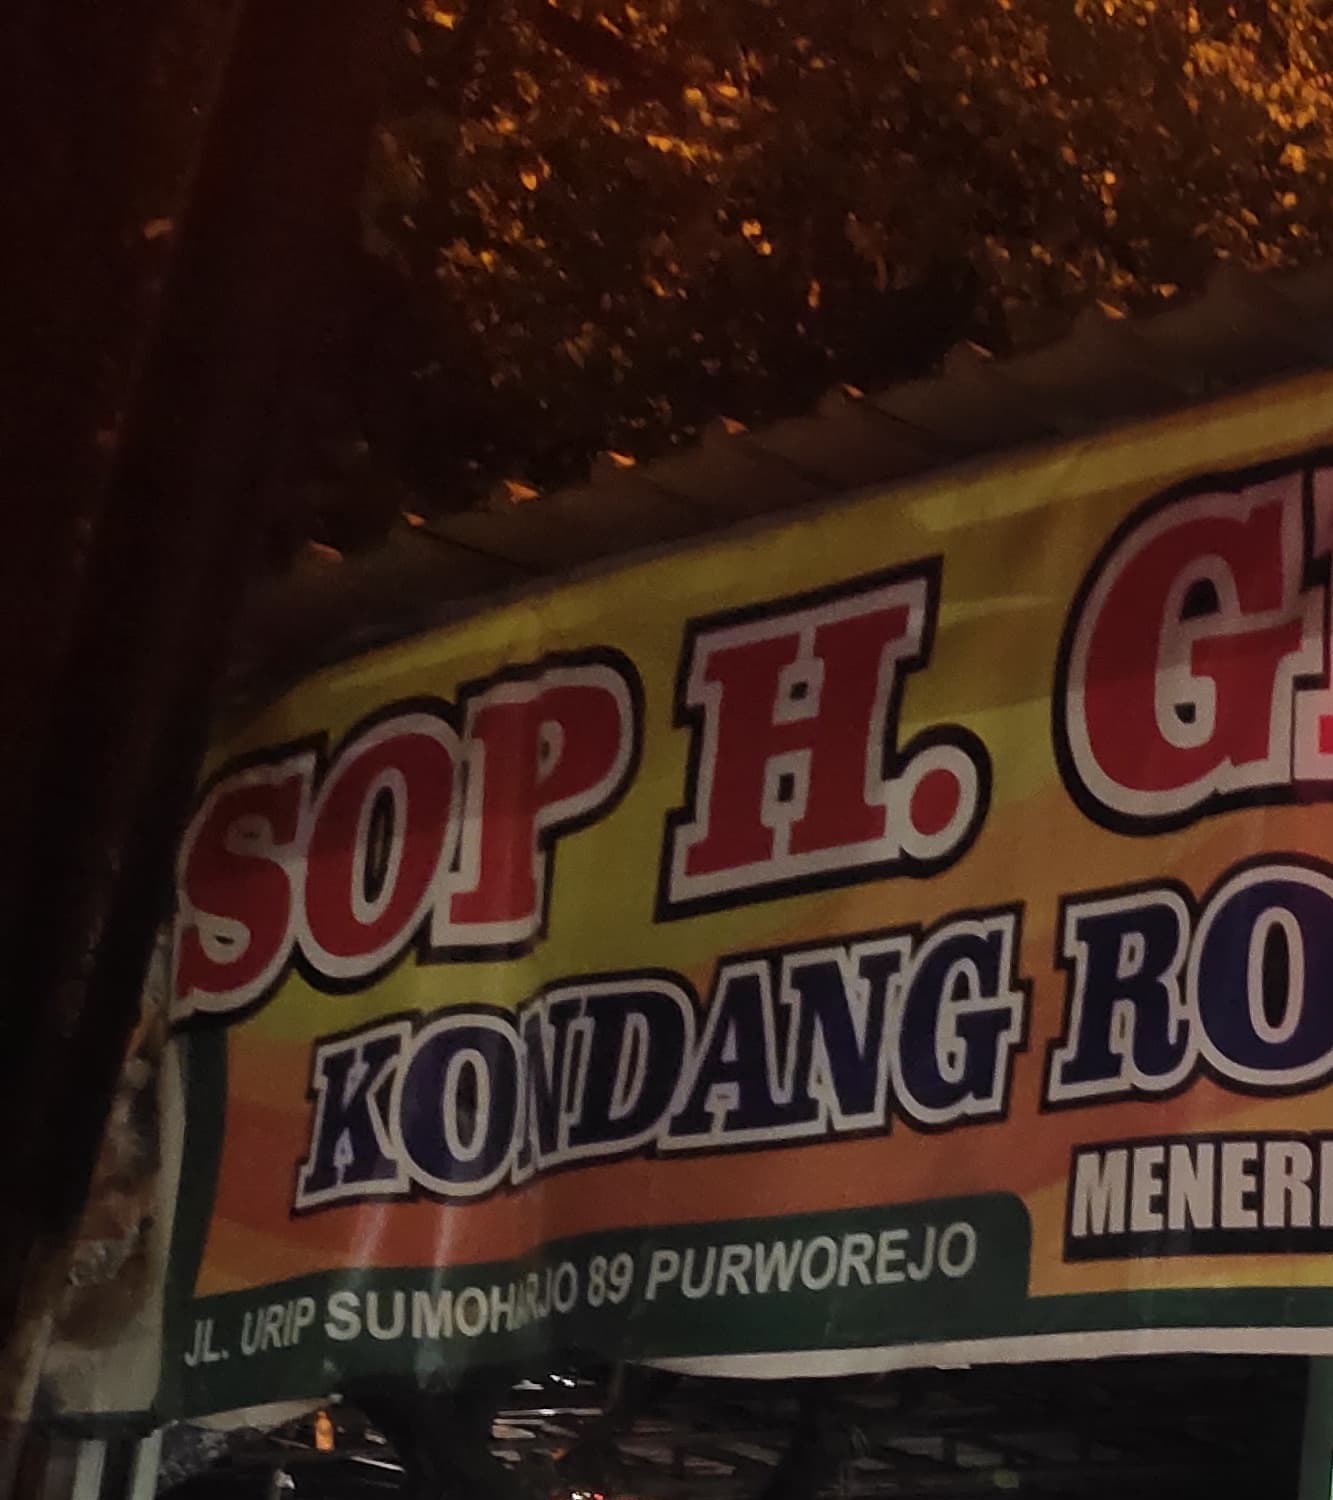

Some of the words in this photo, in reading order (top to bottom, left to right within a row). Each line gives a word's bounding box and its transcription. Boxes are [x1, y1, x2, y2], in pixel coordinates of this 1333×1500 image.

[170, 665, 636, 1010] SOP
[666, 577, 972, 905] H.
[297, 915, 1023, 1210] KONDANG
[184, 1319, 229, 1366] JL.
[240, 1298, 316, 1356] URIP
[586, 1252, 634, 1308] 89
[645, 1220, 978, 1300] PURWOREJO
